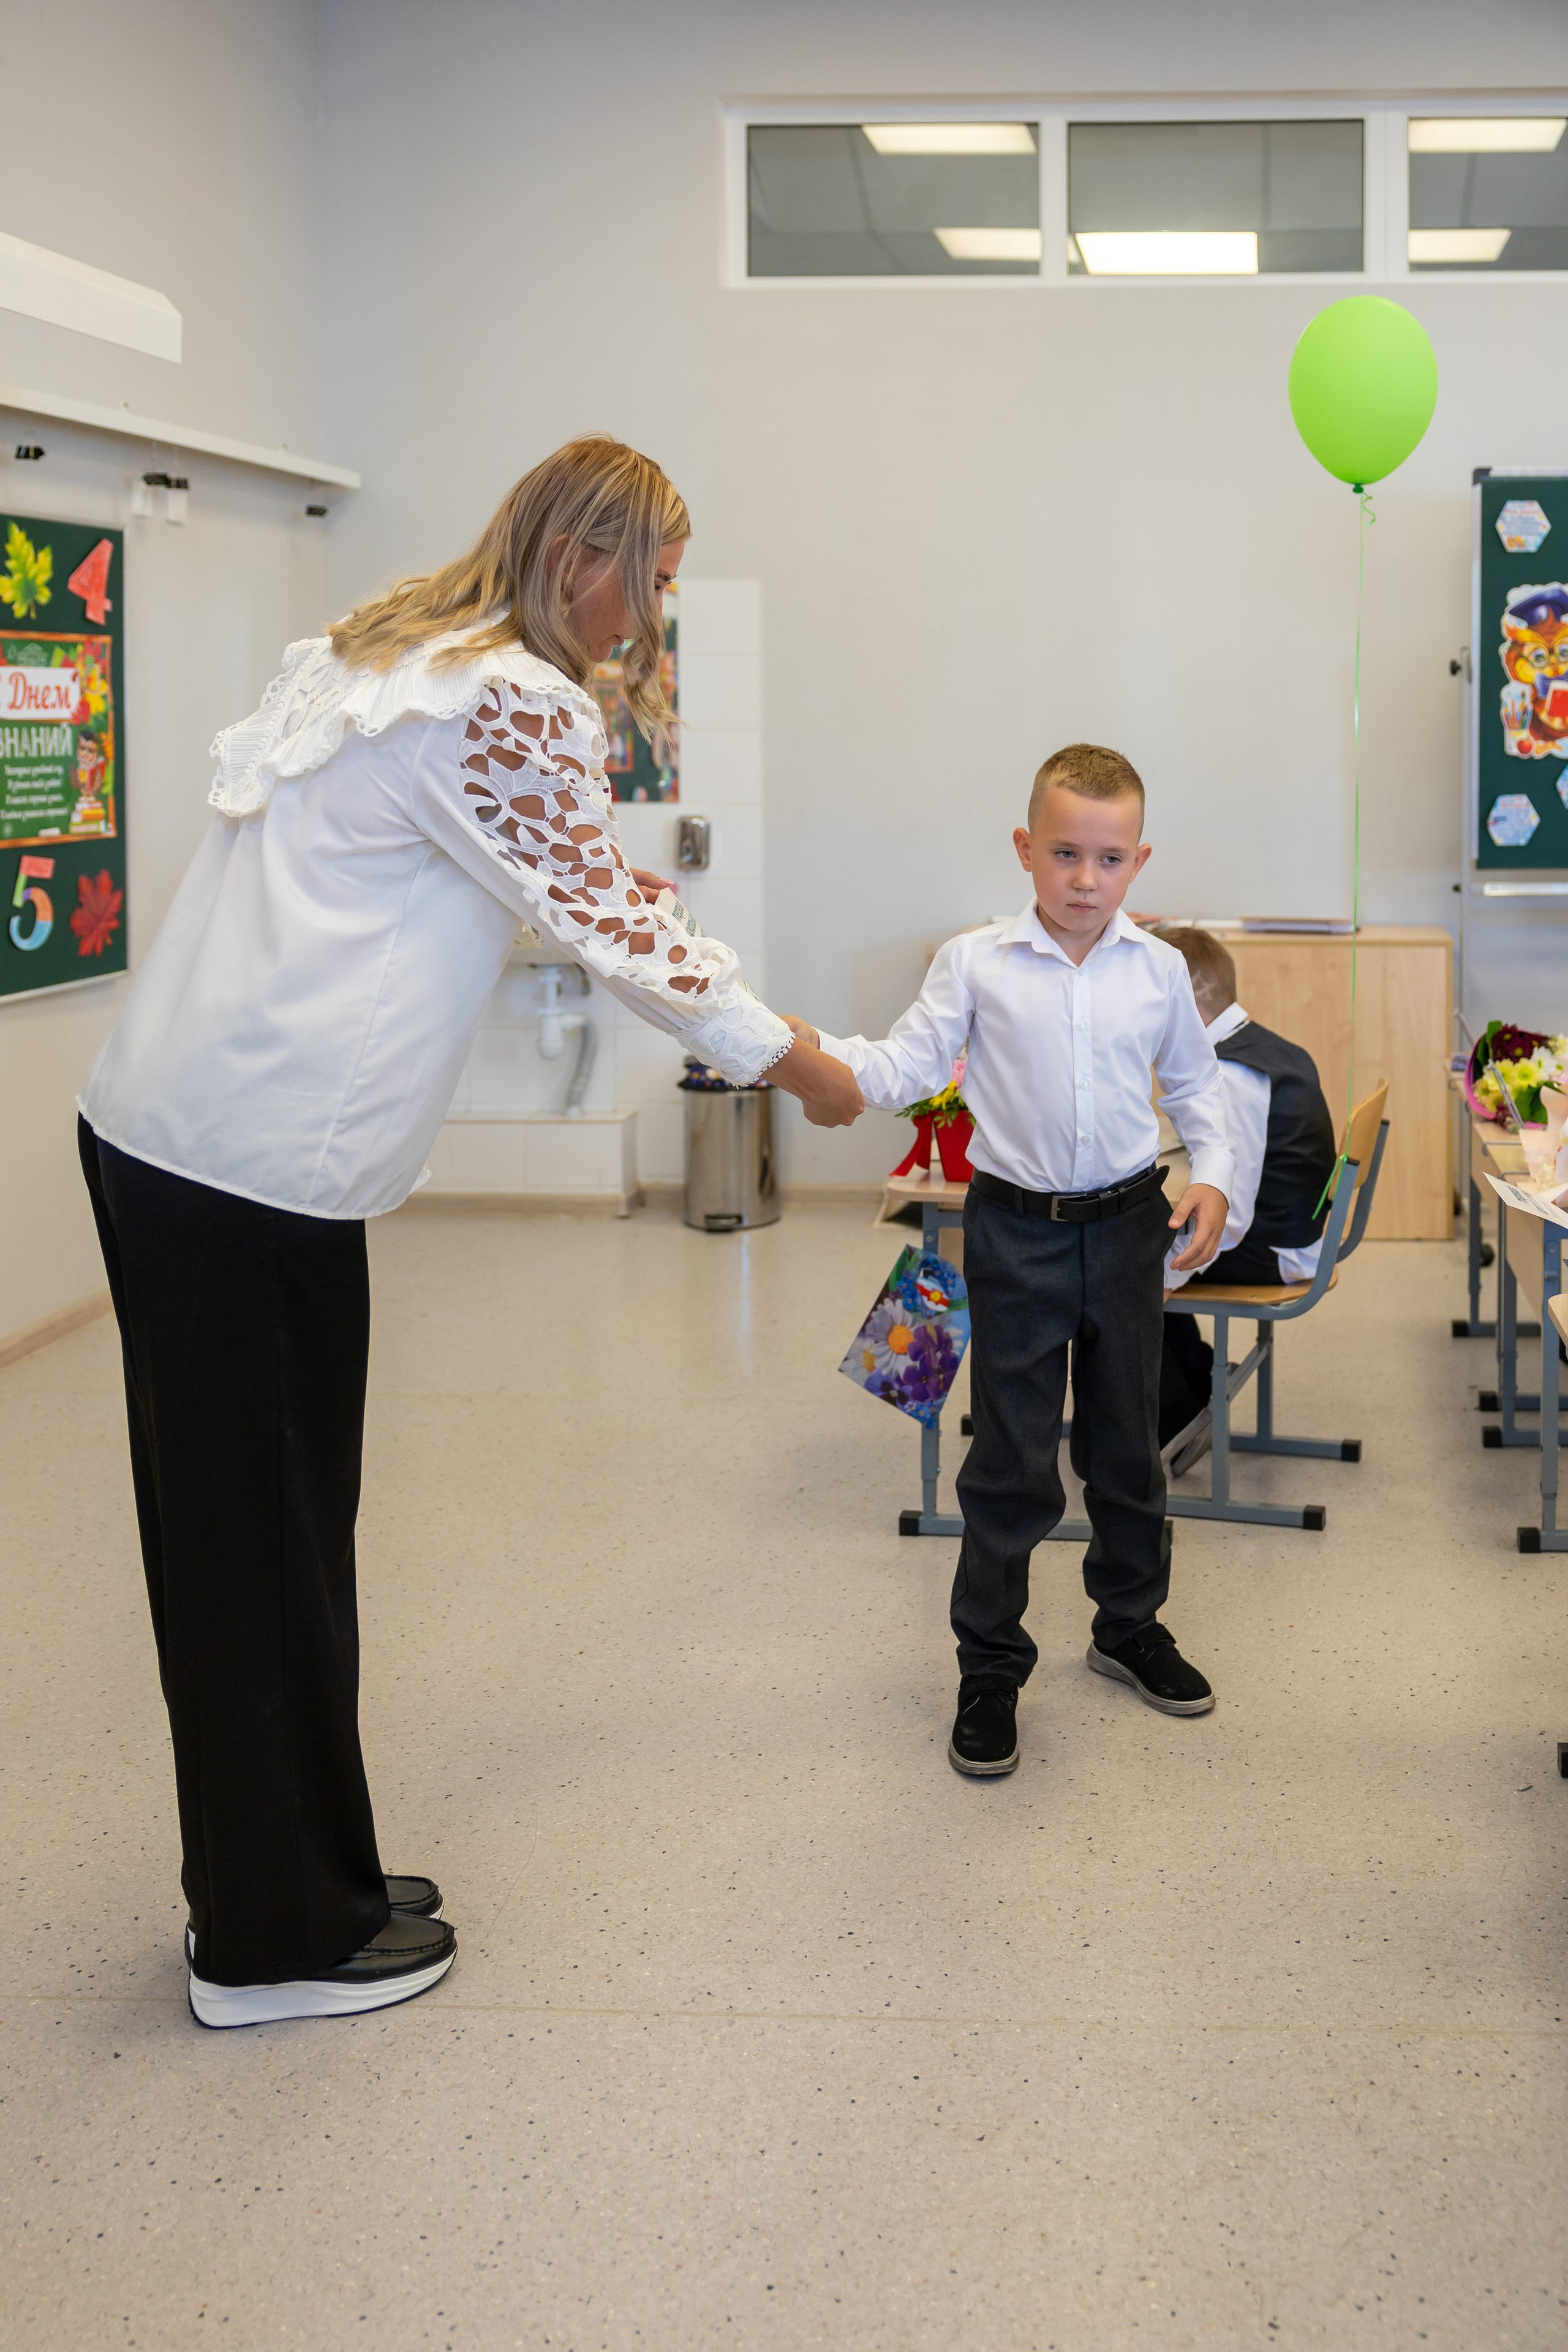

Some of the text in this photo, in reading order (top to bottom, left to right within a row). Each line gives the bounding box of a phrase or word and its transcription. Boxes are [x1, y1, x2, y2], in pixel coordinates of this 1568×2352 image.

[67, 538, 115, 626] 4
[9, 672, 71, 709] Днем
[9, 854, 56, 951] 5
